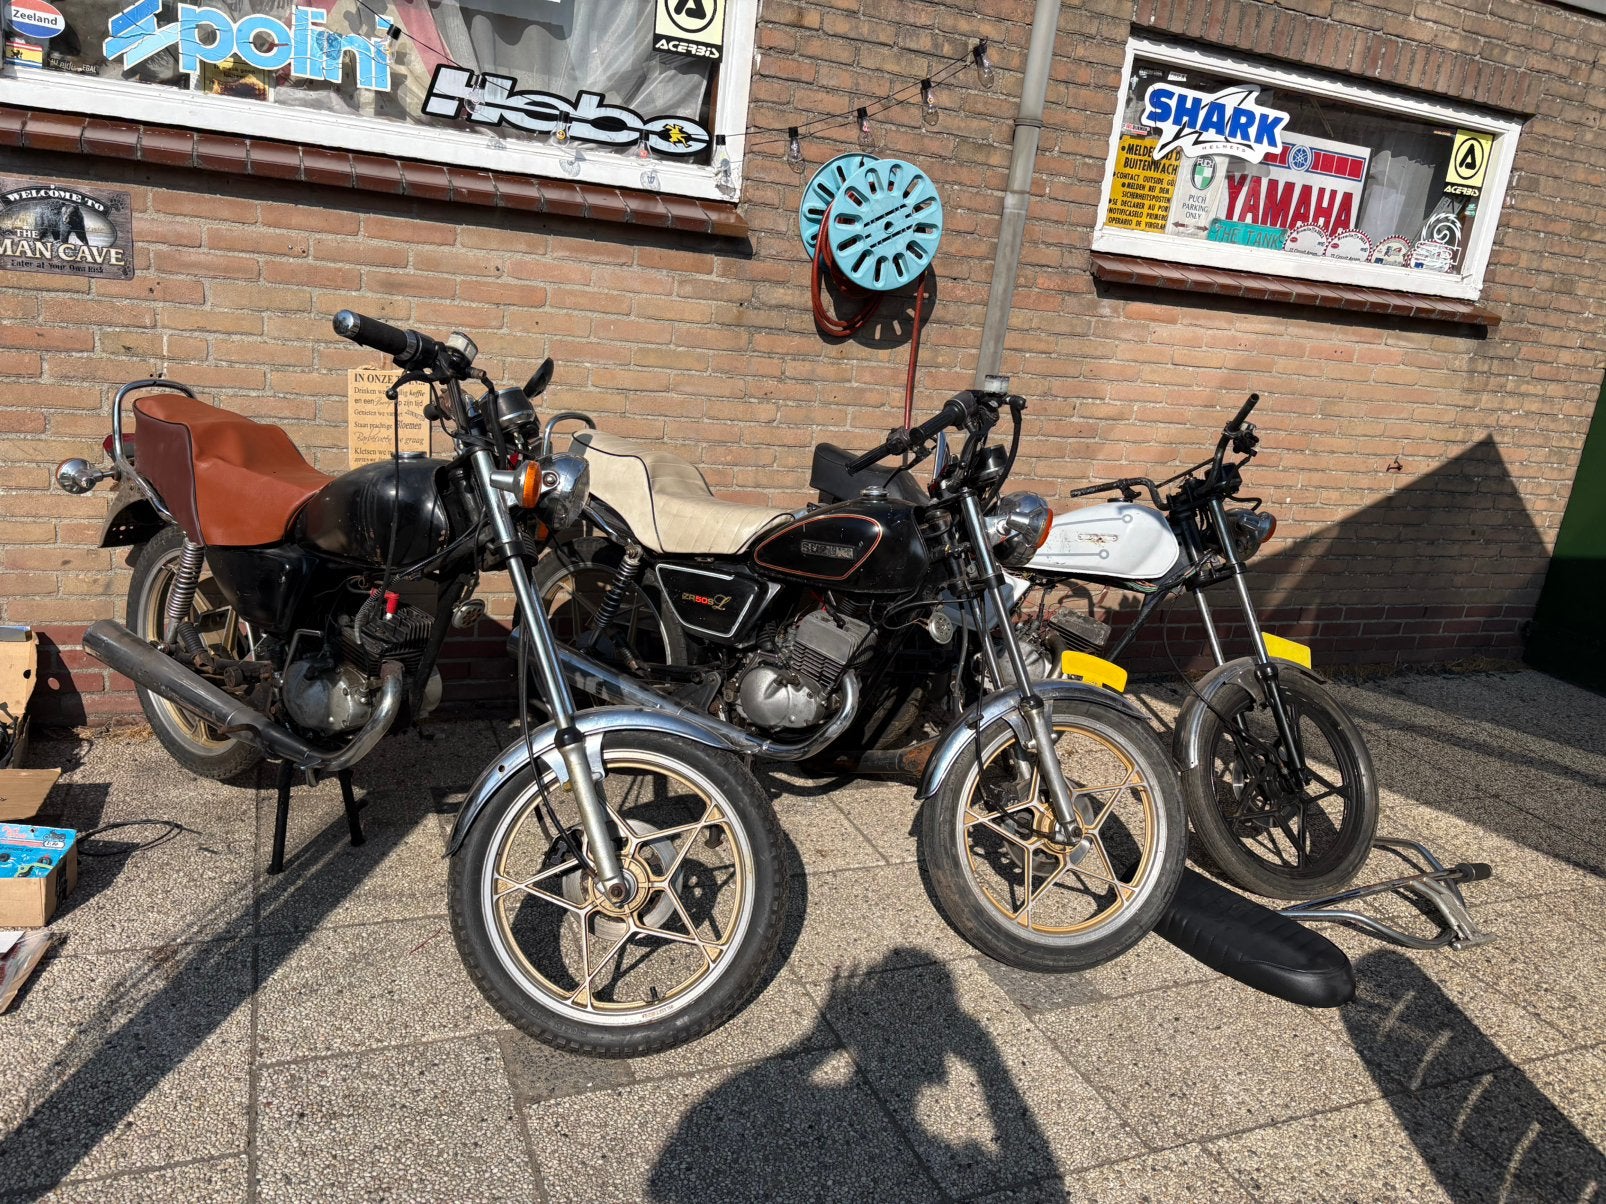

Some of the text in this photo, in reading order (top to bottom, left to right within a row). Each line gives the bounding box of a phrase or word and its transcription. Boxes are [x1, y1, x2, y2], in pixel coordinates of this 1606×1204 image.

[13, 9, 58, 26] Zeeland
[178, 3, 392, 92] polini
[655, 38, 720, 59] ACERBIS
[421, 63, 712, 158] Hebo
[1146, 88, 1285, 148] SHARK
[1126, 143, 1155, 158] MELDE
[1202, 145, 1247, 153] HELMETS
[1116, 171, 1140, 182] CONTACT
[1143, 176, 1165, 186] OUTSIDE
[1126, 182, 1146, 191] MELDEN
[1159, 187, 1170, 195] DEM
[1443, 184, 1479, 197] ACERBIS
[5, 189, 105, 212] WELCOME TO
[1112, 198, 1119, 206] SE
[1121, 199, 1145, 210] DECLARER
[1148, 203, 1156, 212] AU
[1188, 194, 1207, 204] PUCH
[1225, 173, 1354, 238] YAMAHA
[1108, 207, 1144, 219] NOTIFICASELO
[1182, 202, 1209, 213] PARKING
[1108, 216, 1133, 226] OPERARIO
[1185, 210, 1202, 220] ONLY
[15, 229, 40, 239] THE
[1214, 225, 1241, 245] THE
[0, 238, 125, 266] MAN CAVE
[11, 260, 33, 269] Enter
[48, 262, 65, 271] Your
[69, 264, 86, 273] Own
[88, 266, 104, 274] Risk
[354, 373, 365, 383] IN
[367, 374, 393, 384] ONZE
[354, 386, 377, 395] Drinken
[354, 447, 377, 456] Kletsen
